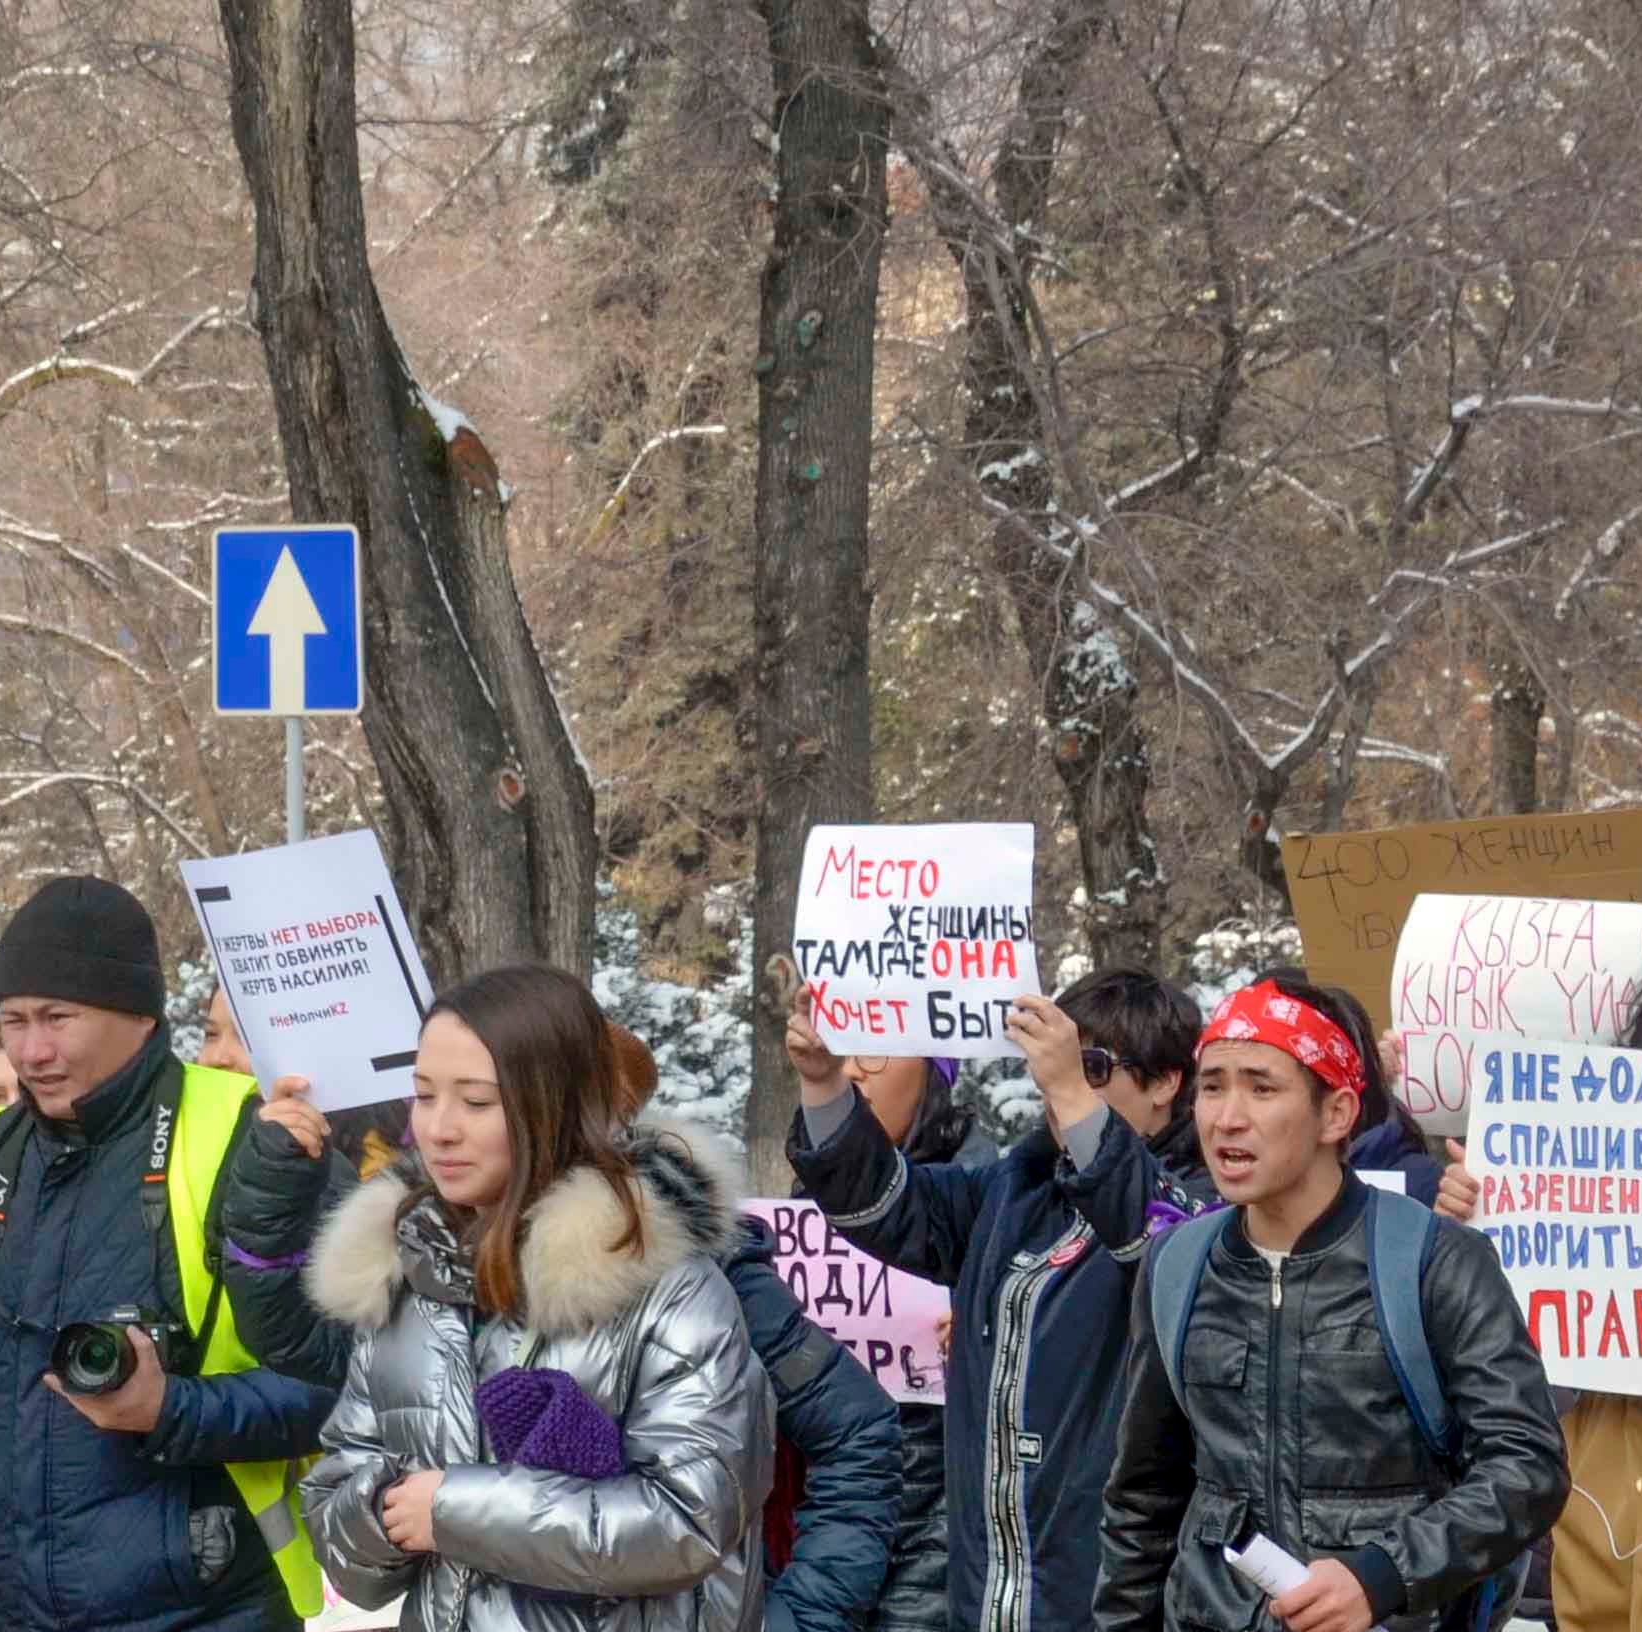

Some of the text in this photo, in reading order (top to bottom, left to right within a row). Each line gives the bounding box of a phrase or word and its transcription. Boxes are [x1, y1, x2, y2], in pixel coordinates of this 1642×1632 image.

[1432, 823, 1614, 875] ЖЕНЩИН
[222, 934, 269, 952] ЖЕРТВЫ
[270, 926, 302, 946] НЕТ
[306, 911, 380, 939] ВЫБОРА
[883, 904, 1034, 943] ЖЕНЩИНЫ
[231, 937, 368, 974] ХВАТИТ ОБВИНЯТЬ
[931, 940, 1018, 979] ОНА
[241, 959, 371, 995] ЖЕРТВ НАСИЛИЯ!
[927, 990, 1019, 1040] БЫТ
[1485, 1051, 1504, 1104] Я
[1512, 1052, 1560, 1102] НЕ
[150, 1104, 172, 1169] SONY
